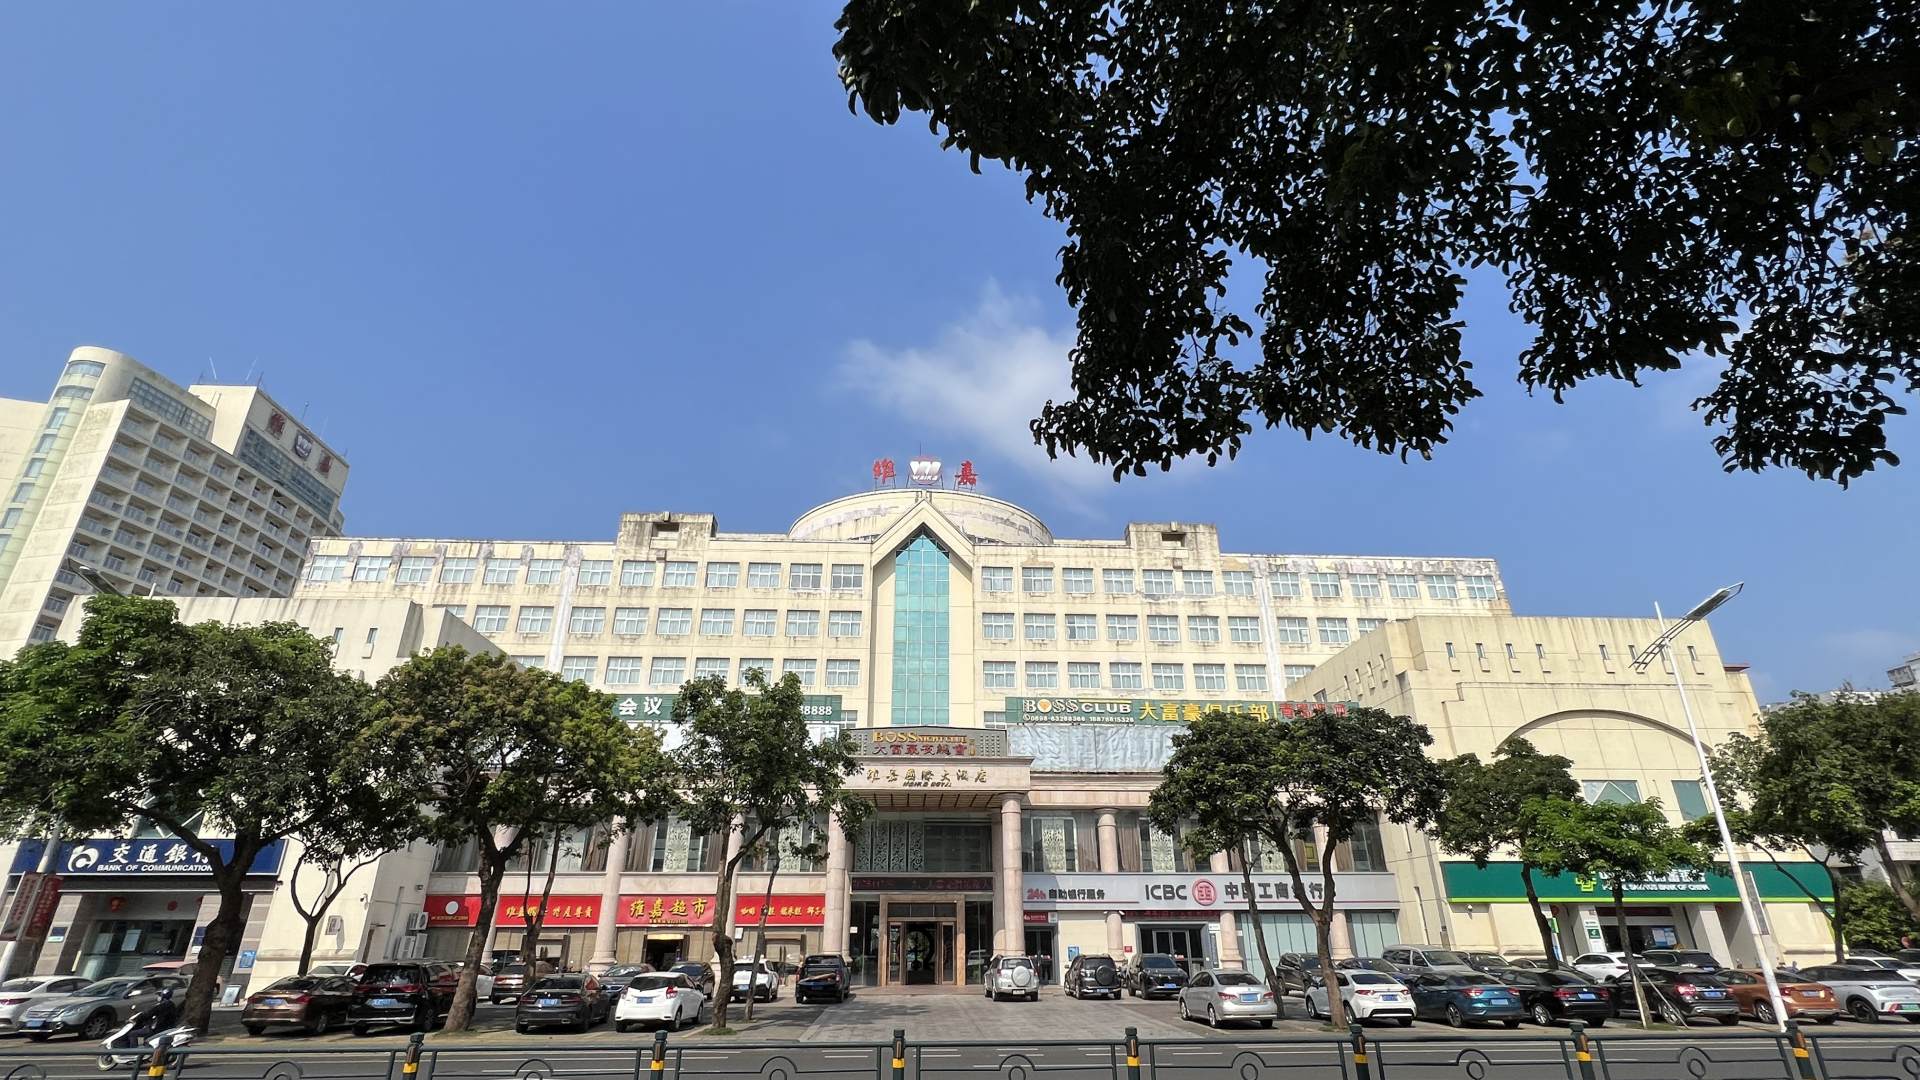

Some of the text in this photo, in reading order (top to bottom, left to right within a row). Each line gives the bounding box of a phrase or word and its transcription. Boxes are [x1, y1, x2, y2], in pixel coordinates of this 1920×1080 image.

[618, 696, 663, 716] 会议
[1081, 703, 1132, 713] CLUB
[97, 864, 121, 872] BANK
[126, 864, 138, 872] OF
[1048, 888, 1105, 900] 自助银行服务
[1145, 884, 1188, 900] ICBC
